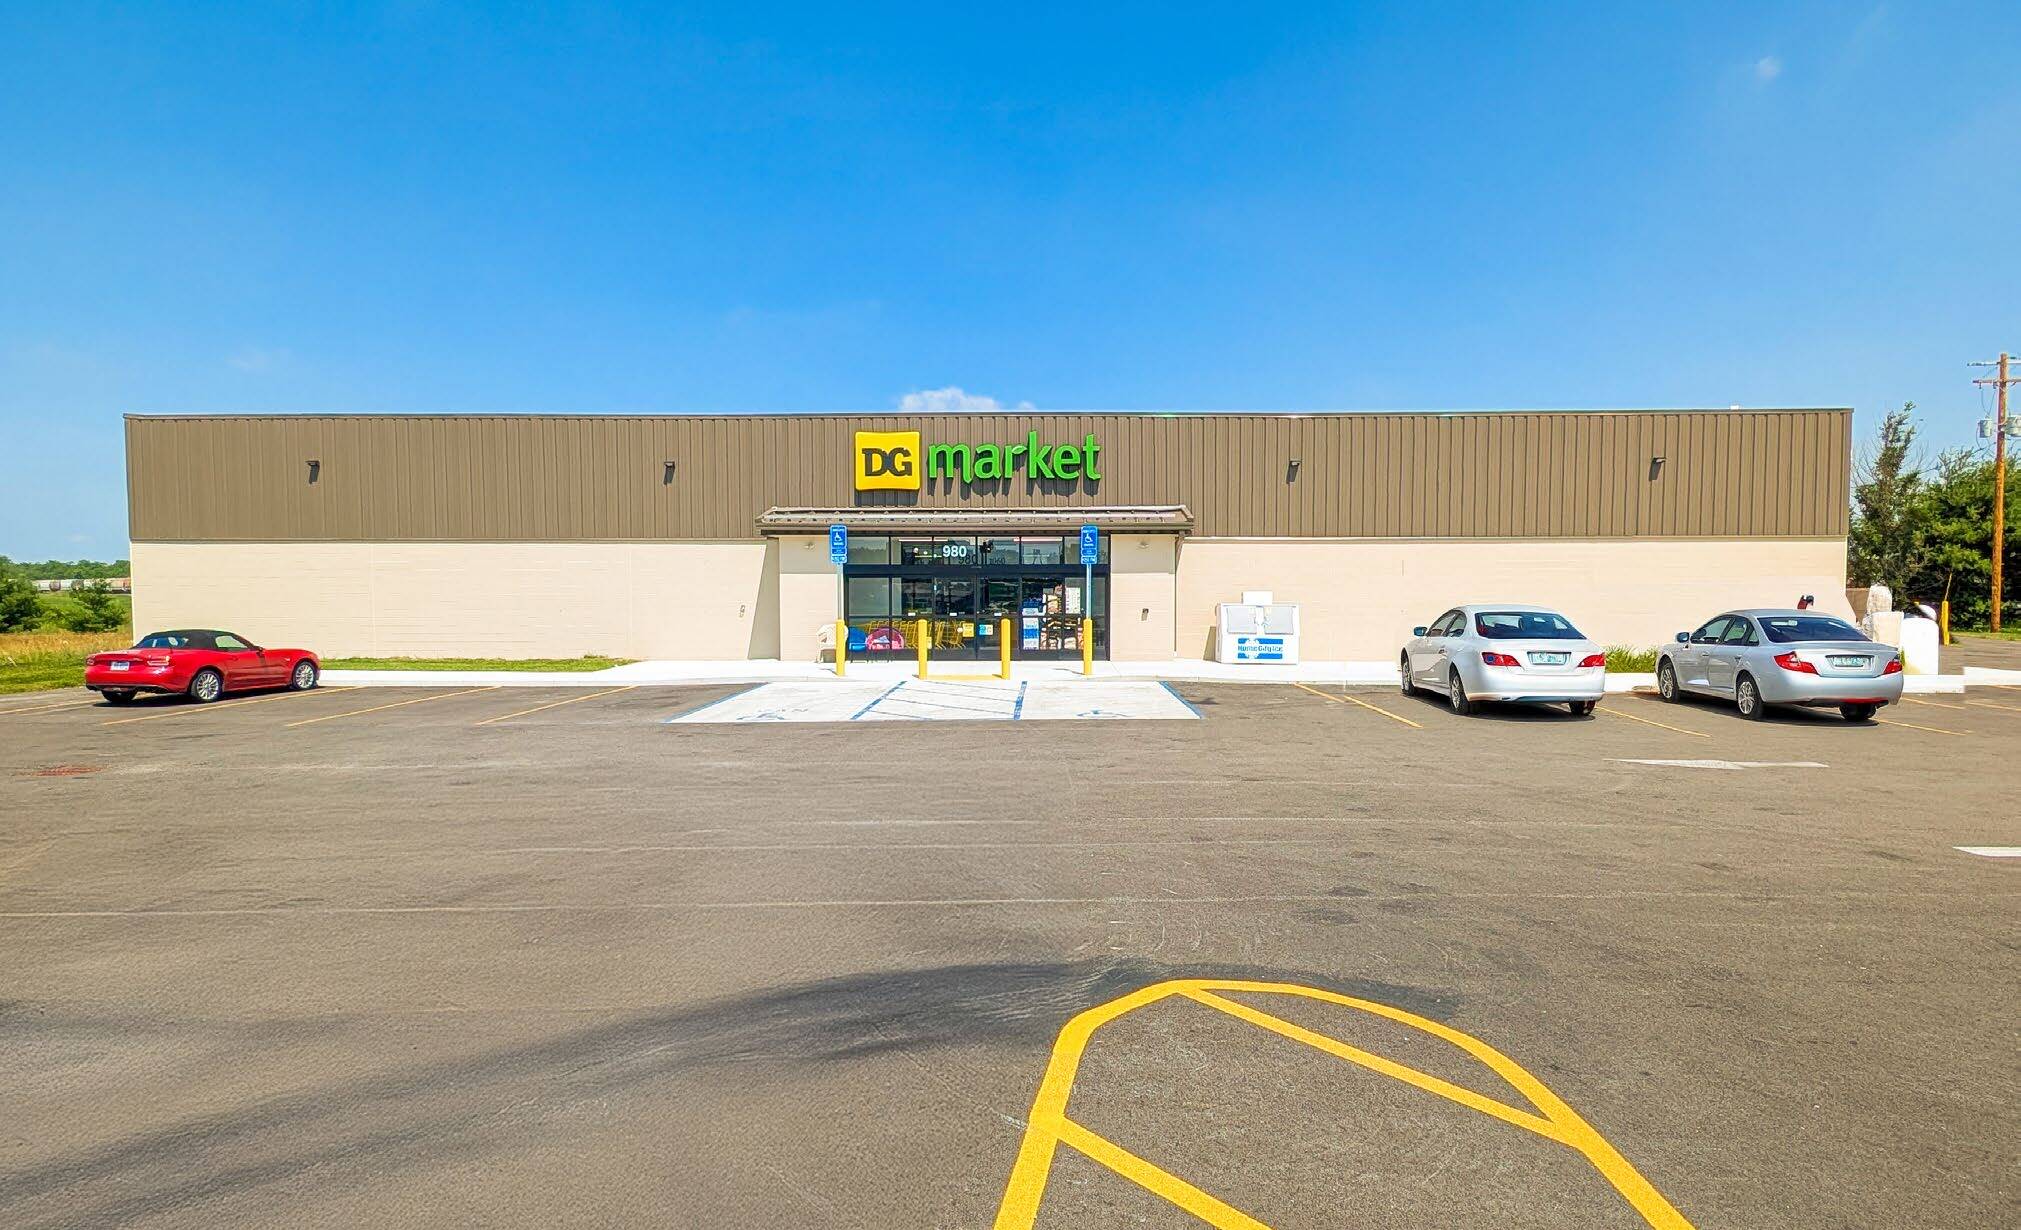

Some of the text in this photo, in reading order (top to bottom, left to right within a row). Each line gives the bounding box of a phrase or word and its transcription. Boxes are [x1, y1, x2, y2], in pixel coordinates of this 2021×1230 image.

[862, 431, 1101, 483] DG market
[942, 545, 967, 557] 980
